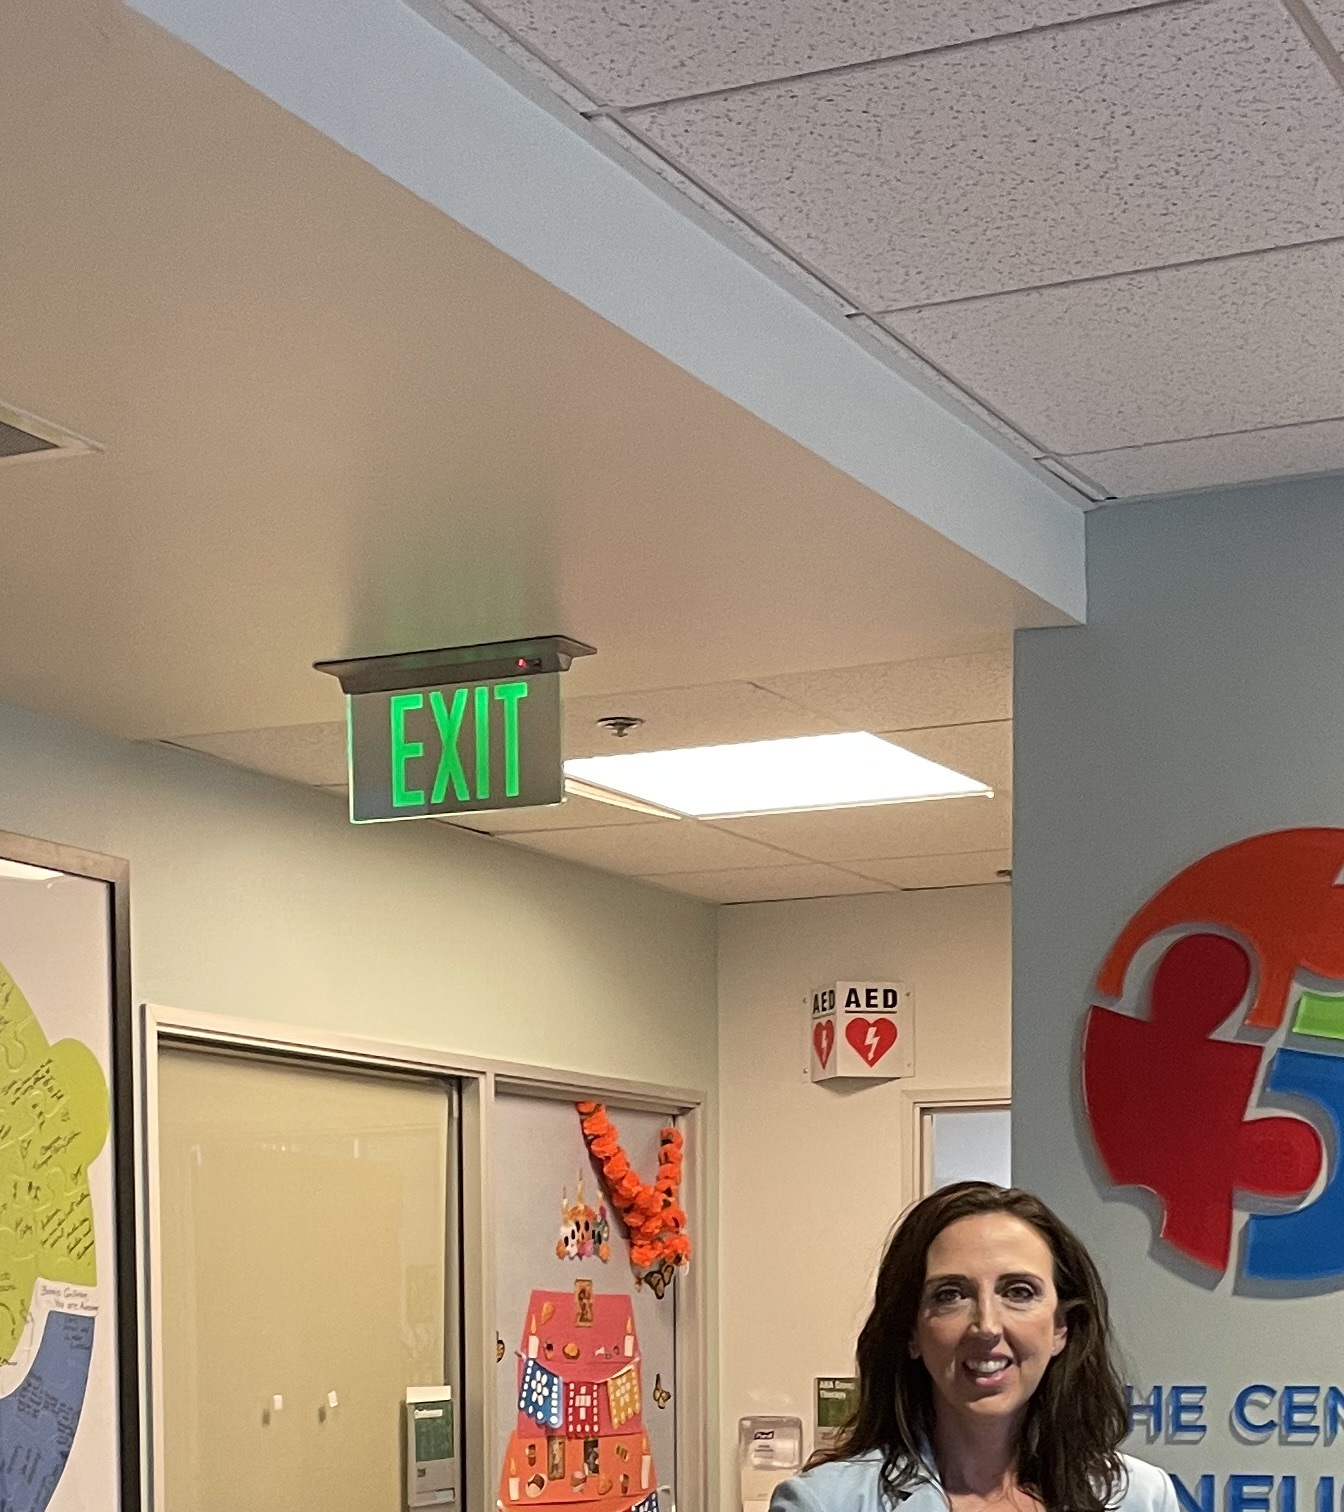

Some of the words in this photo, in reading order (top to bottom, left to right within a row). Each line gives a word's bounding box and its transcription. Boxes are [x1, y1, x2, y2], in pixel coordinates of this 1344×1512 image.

[391, 682, 527, 807] EXIT
[812, 989, 835, 1015] AED
[844, 988, 898, 1010] AED
[1121, 1385, 1208, 1438] HE
